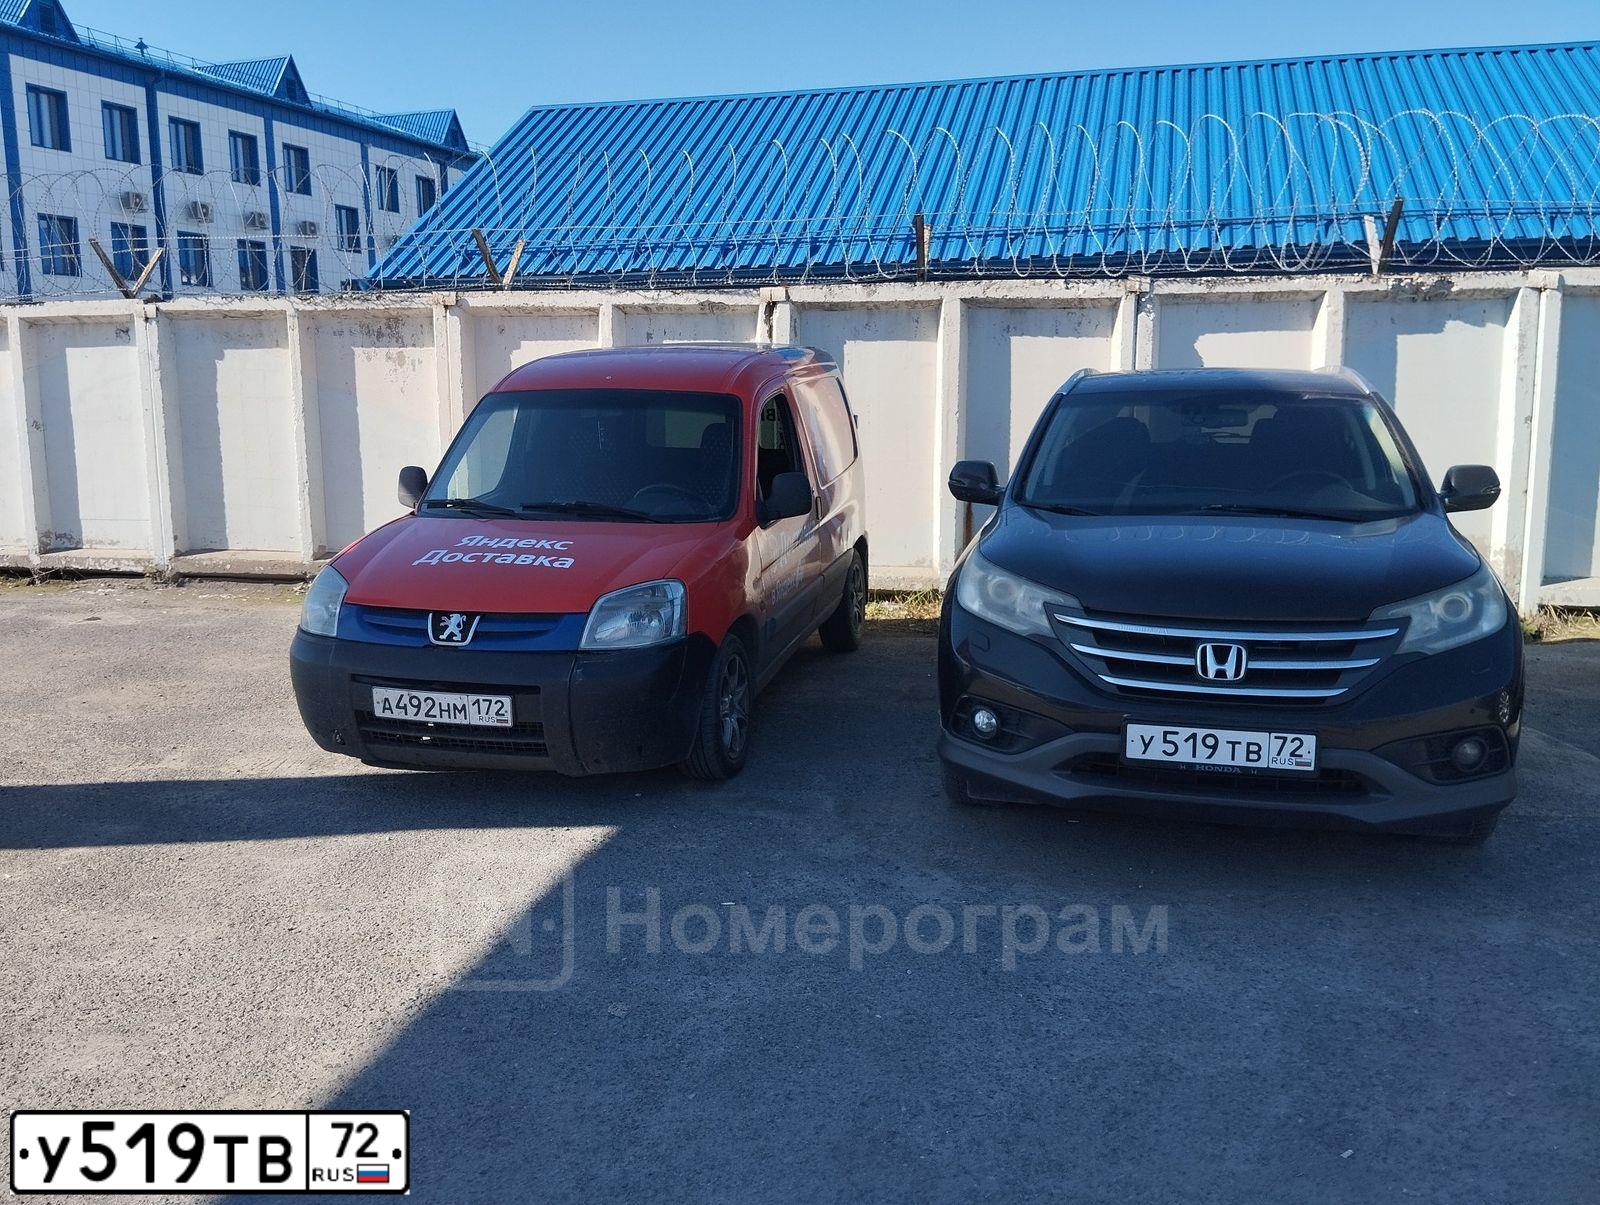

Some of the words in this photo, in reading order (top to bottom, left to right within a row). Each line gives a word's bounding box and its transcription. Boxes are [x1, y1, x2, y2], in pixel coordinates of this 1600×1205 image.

[454, 535, 574, 550] Яндекс
[412, 549, 576, 569] Доставка
[471, 698, 506, 717] 172
[478, 715, 496, 724] RUS
[1273, 736, 1305, 758] 72
[1196, 764, 1242, 774] HONDA
[1271, 757, 1295, 766] RUS
